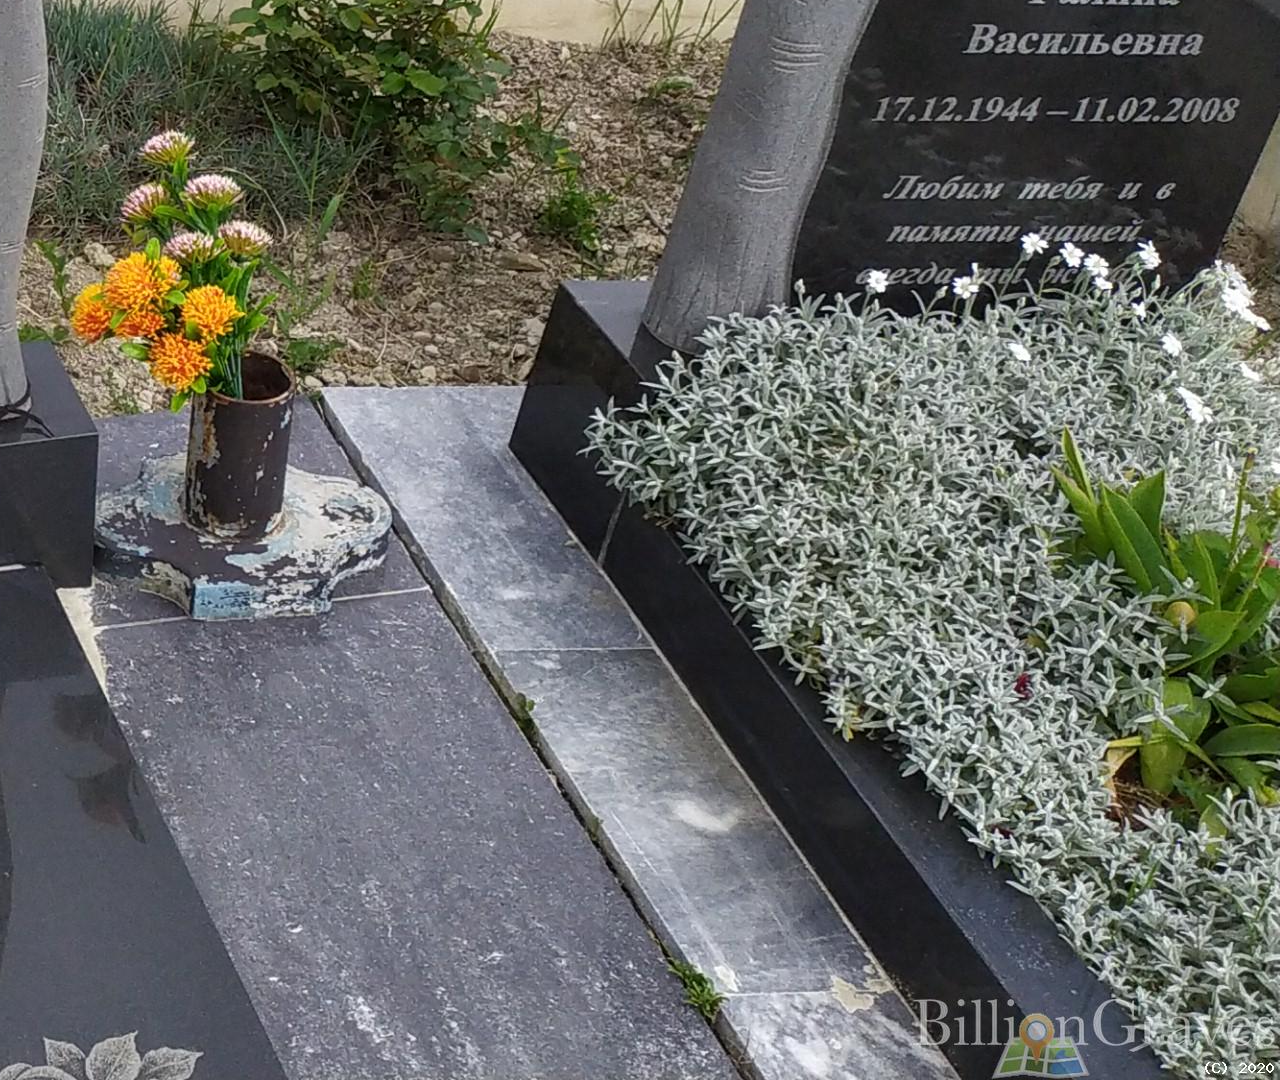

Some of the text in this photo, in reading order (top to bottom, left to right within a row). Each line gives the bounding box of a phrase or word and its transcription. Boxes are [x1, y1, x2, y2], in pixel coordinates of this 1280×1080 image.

[963, 24, 1204, 56] Васильевна
[883, 175, 1176, 201] Любим тебя и в
[886, 224, 1021, 243] памяти
[855, 261, 958, 286] вегда
